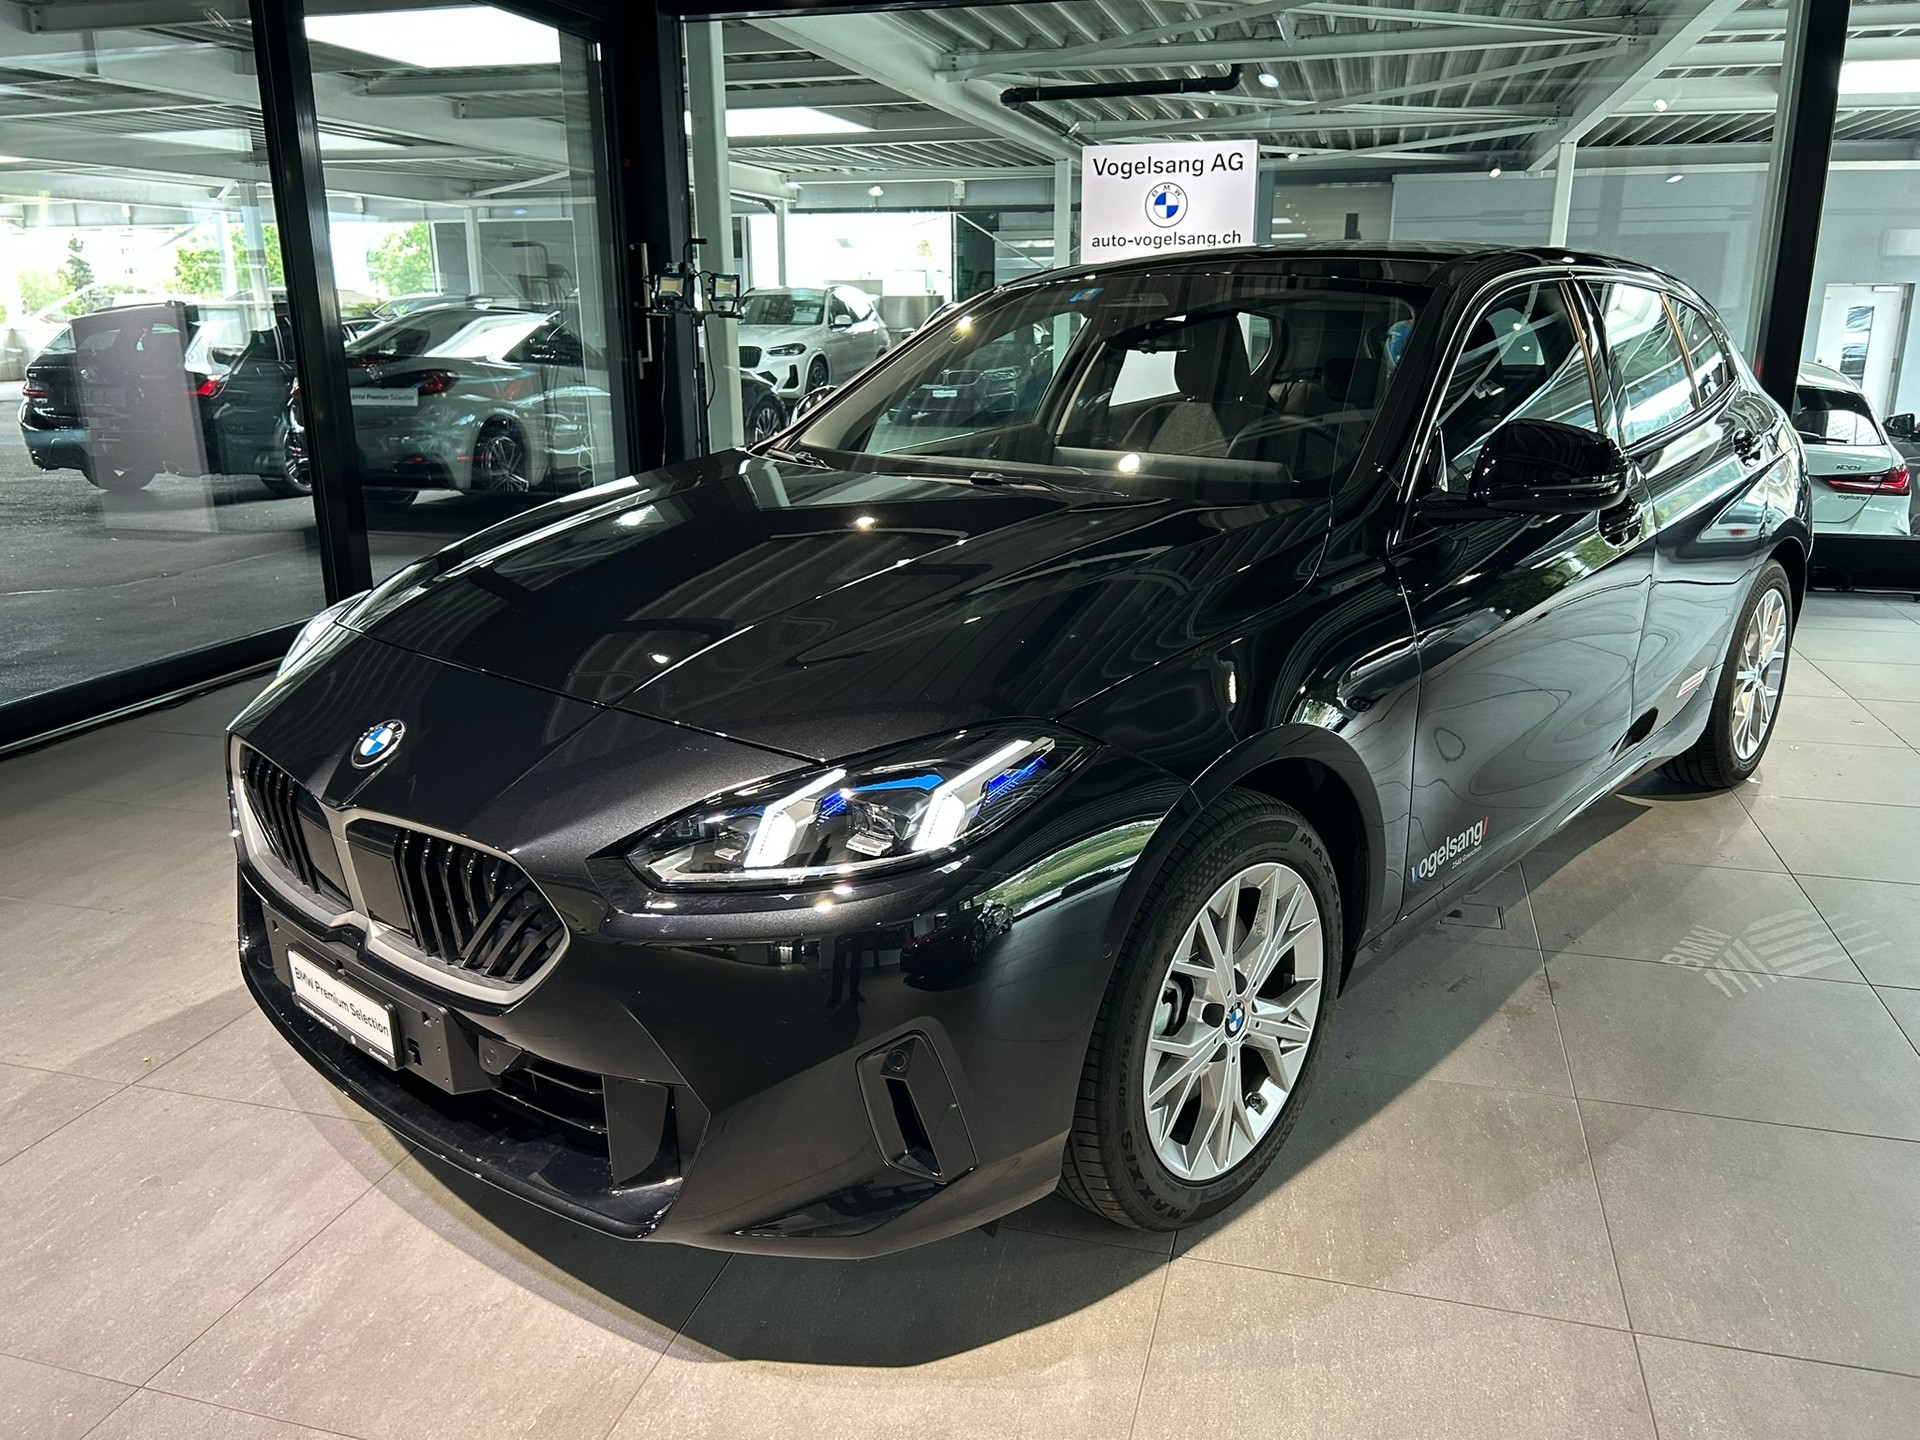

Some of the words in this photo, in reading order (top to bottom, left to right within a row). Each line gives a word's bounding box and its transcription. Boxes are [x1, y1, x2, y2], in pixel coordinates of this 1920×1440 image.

[1093, 156, 1204, 179] Vogelsang
[1210, 152, 1244, 172] AG
[1152, 184, 1182, 198] BMW
[1091, 230, 1242, 249] auto-vogelsang.ch
[1660, 924, 1732, 972] BMW
[294, 967, 314, 989] BMW
[315, 981, 350, 1012] Premium
[350, 1002, 390, 1037] Selection
[1121, 1129, 1187, 1219] MAXXIS
